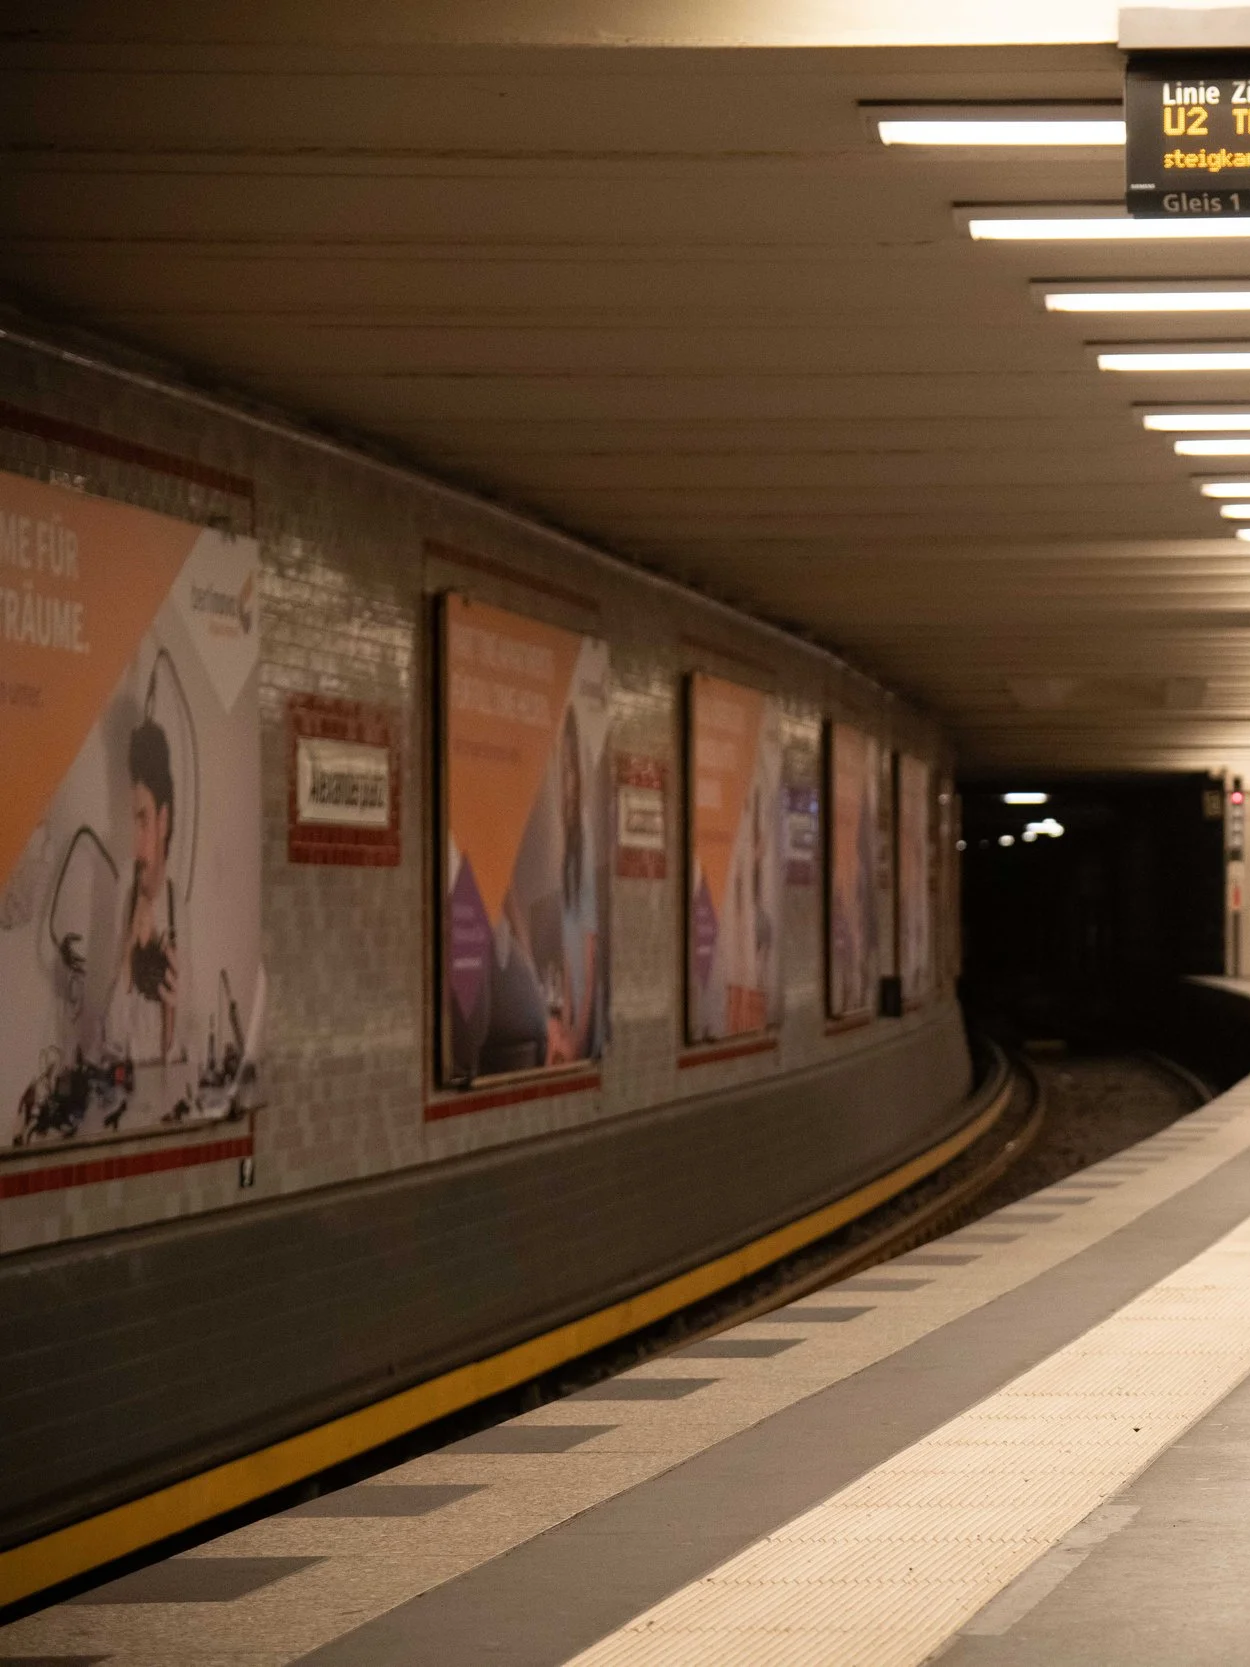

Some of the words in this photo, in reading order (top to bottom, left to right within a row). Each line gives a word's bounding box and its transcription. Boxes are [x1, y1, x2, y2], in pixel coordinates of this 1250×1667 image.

[1162, 81, 1221, 106] Linie
[1163, 105, 1209, 136] U2
[1162, 192, 1223, 213] Gleis
[1229, 192, 1241, 212] 1
[36, 512, 80, 582] FÜR
